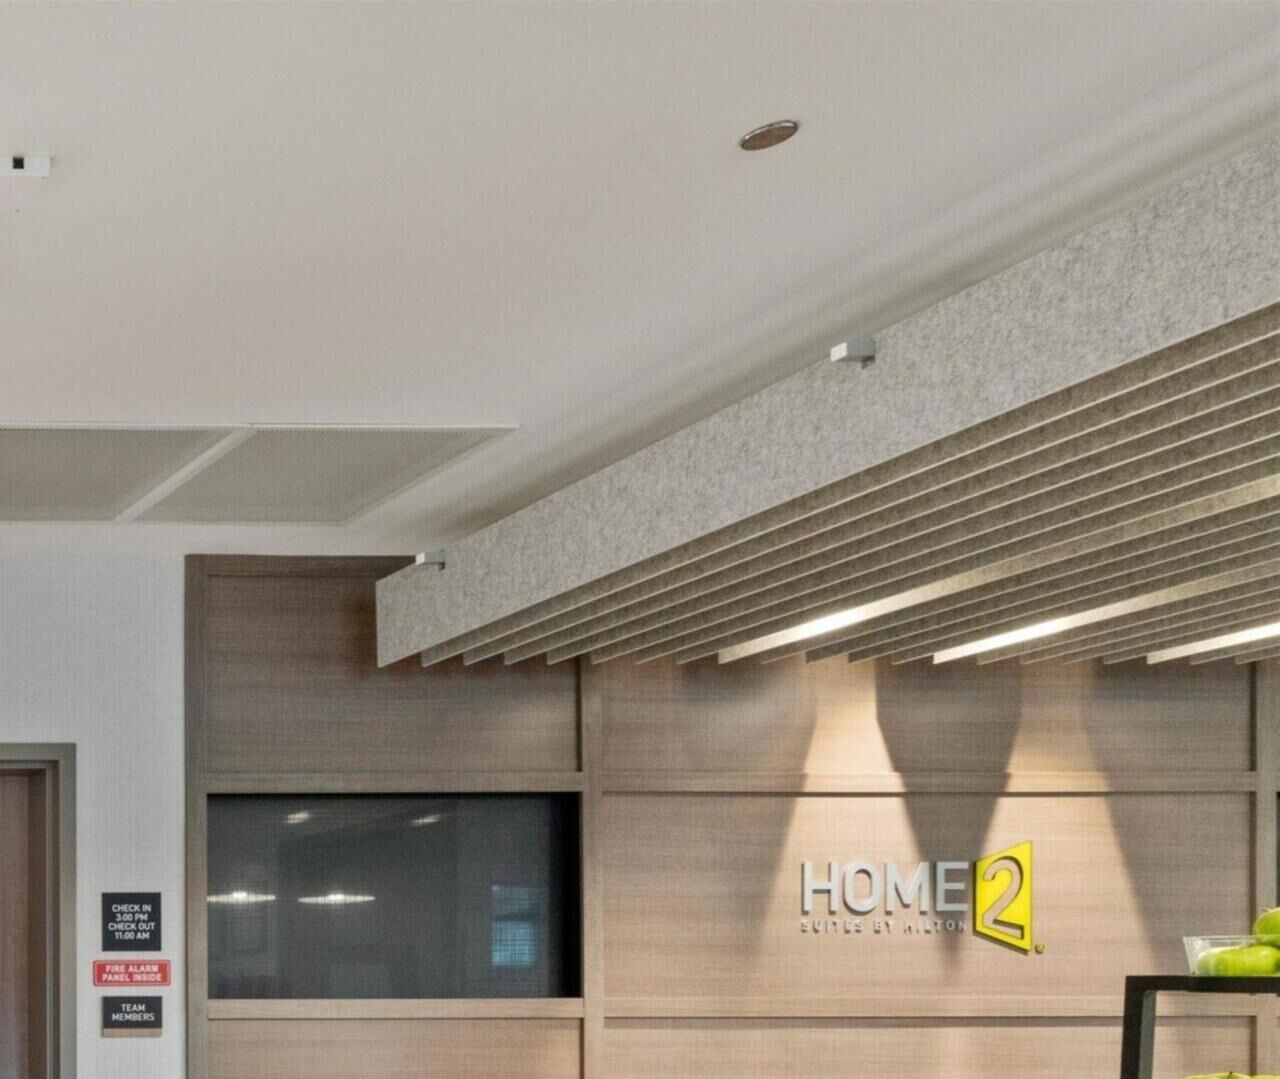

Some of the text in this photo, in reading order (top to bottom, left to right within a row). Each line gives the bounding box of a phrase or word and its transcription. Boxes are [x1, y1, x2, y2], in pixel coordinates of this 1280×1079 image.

[112, 904, 152, 912] CHECK IN
[134, 913, 148, 921] PM
[108, 922, 155, 931] CHECK OUT
[801, 919, 969, 934] SUITES BY HILTON
[114, 931, 150, 940] 11:00 AM
[105, 964, 159, 973] FIRE ALARM
[102, 973, 162, 982] PANEL INSIDE
[121, 1003, 146, 1012] TEAM
[112, 1012, 155, 1021] MEMBERS
